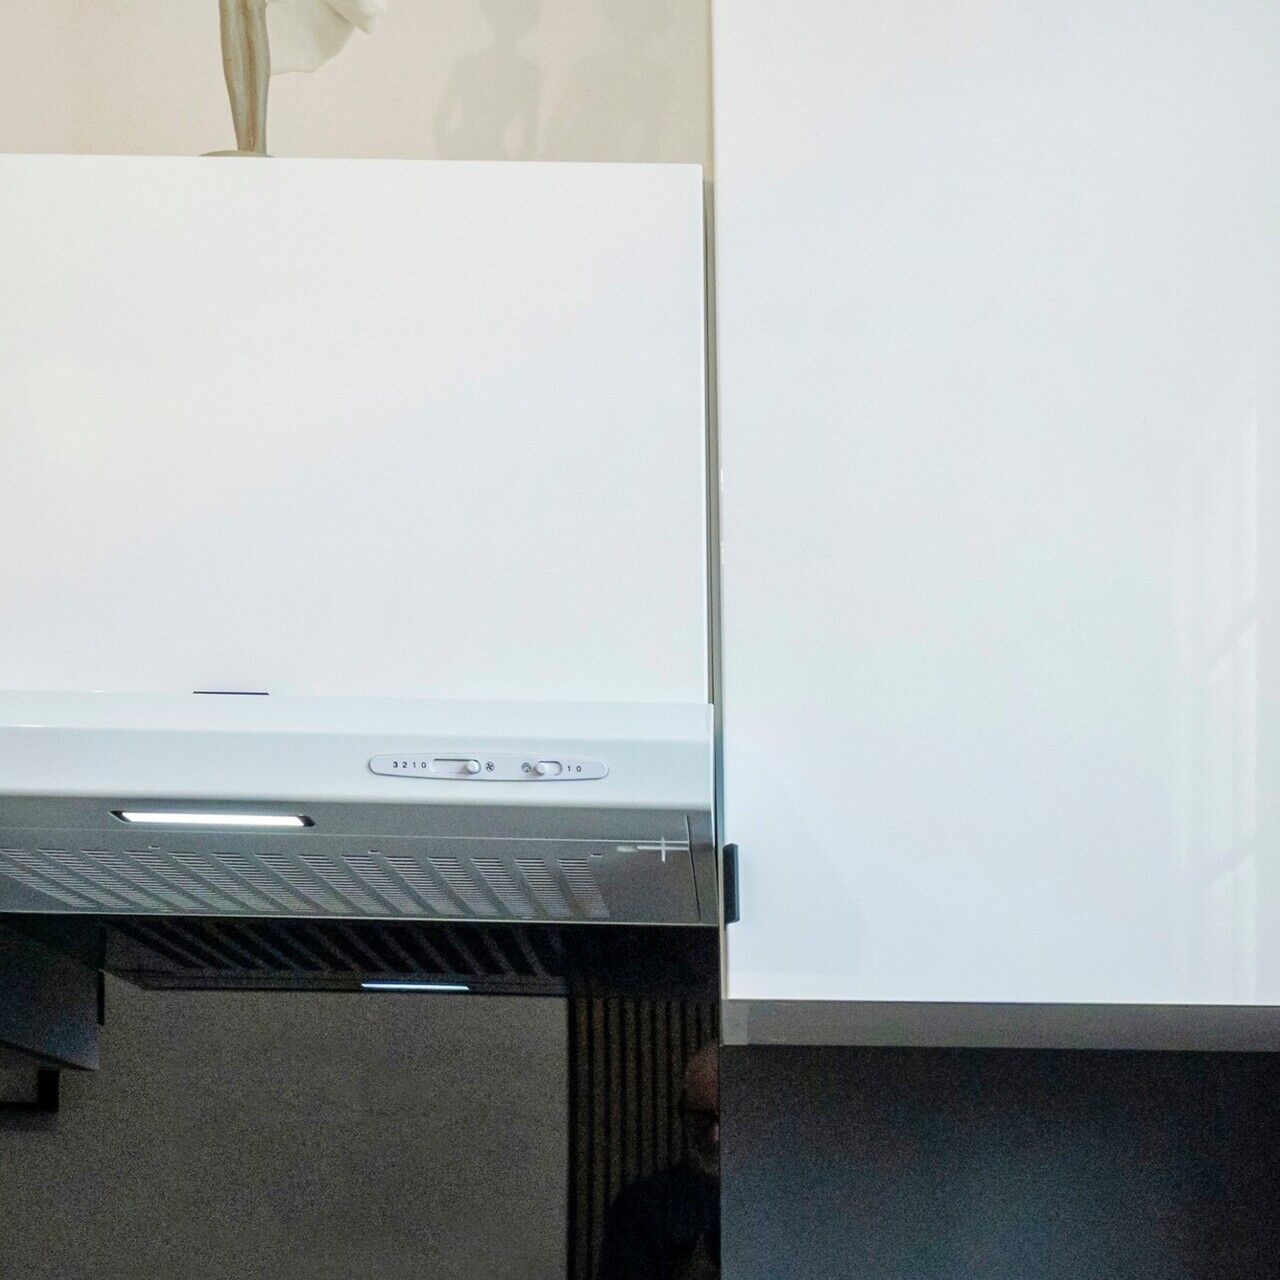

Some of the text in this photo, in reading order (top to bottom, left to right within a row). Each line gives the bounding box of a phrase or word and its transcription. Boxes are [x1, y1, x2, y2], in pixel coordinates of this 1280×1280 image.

[402, 761, 408, 769] 2
[420, 761, 427, 769] 0
[576, 765, 582, 773] 0
